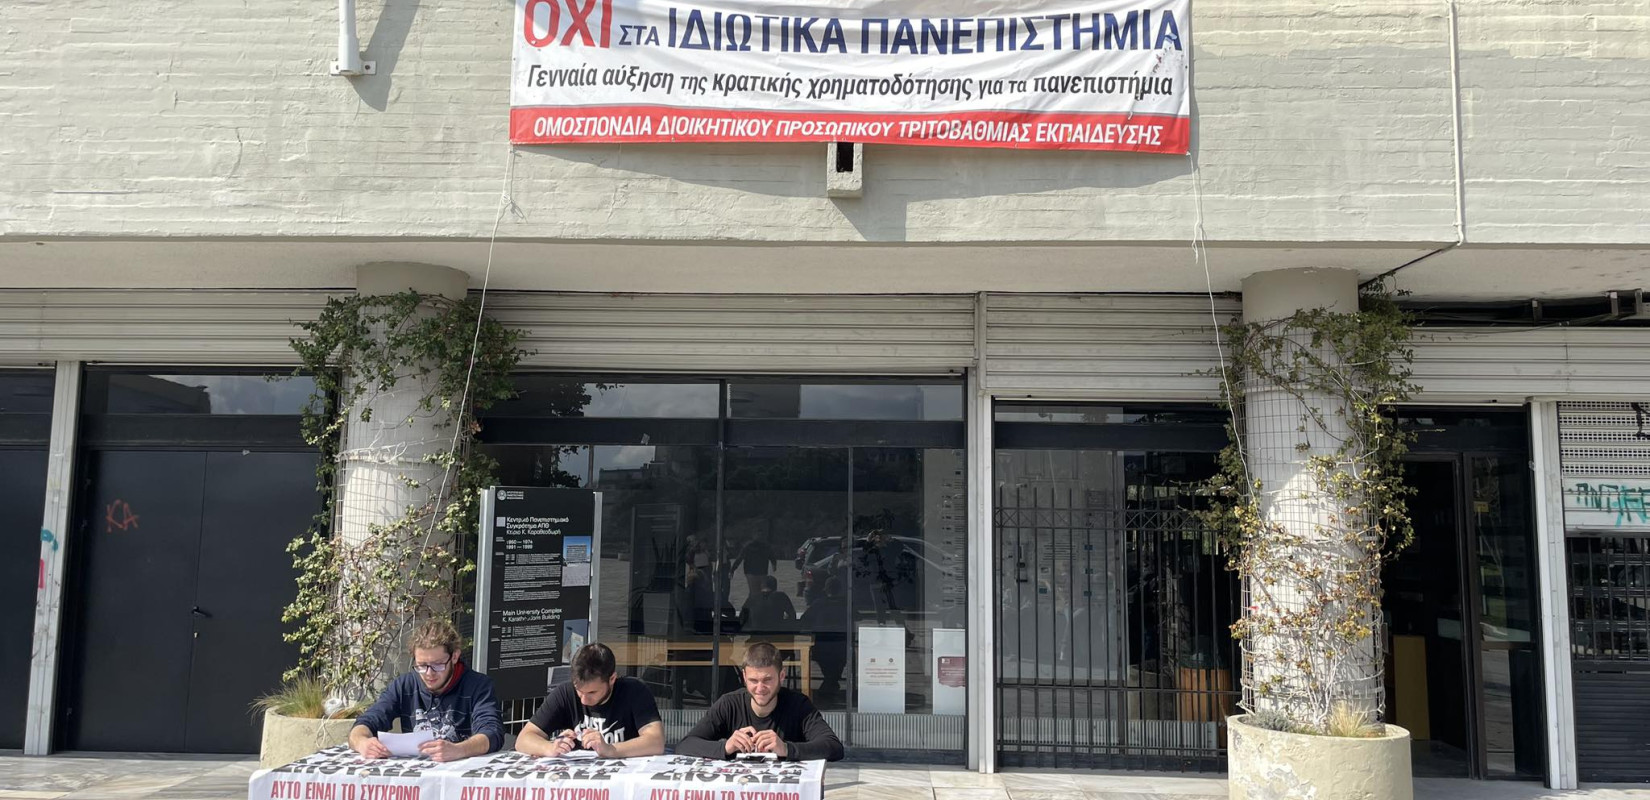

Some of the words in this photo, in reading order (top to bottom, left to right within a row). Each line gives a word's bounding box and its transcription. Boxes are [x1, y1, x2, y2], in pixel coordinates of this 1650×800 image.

[523, 0, 612, 48] ΟΧΙ
[618, 24, 661, 47] ΣΤΑ
[667, 8, 848, 54] ΙΔΙΩΤΙΚΑ
[861, 9, 1183, 55] ΠΑΝΕΠΙΣΤΗΜΙΑ
[527, 63, 597, 89] Γενναία
[602, 65, 674, 94] αύξηση
[680, 75, 708, 95] της
[712, 72, 803, 99] κρατικής
[807, 72, 973, 101] χρηματοδότησης
[978, 77, 1003, 100] για
[1008, 79, 1027, 94] τα
[1033, 70, 1173, 101] πανεπιστήμια
[533, 116, 653, 138] ΟΜΟΣΠΟΝΔΙΑ
[656, 115, 774, 138] ΔΙΟΙΚΗΤΙΚΟΥ
[775, 119, 895, 138] ΠΡΟΣΩΠΙΚΟΥ
[898, 119, 1033, 143] ΤΡΙΤΟΒΑΘΜΙΑΣ
[1035, 122, 1164, 146] ΕΚΠΑΙΔΕΥΣΗΣ
[541, 607, 562, 615] Complex
[271, 780, 301, 798] ΑΥΤΟ
[305, 781, 336, 800] ΕΙΝΑΙ
[341, 783, 355, 800] ΤΟ
[360, 784, 421, 800] ΣΥΓΧΡΟΝΟ
[460, 786, 490, 800] ΑΥΤΟ
[494, 786, 527, 800] ΕΙΝΑΙ
[531, 787, 545, 800] ΤΟ
